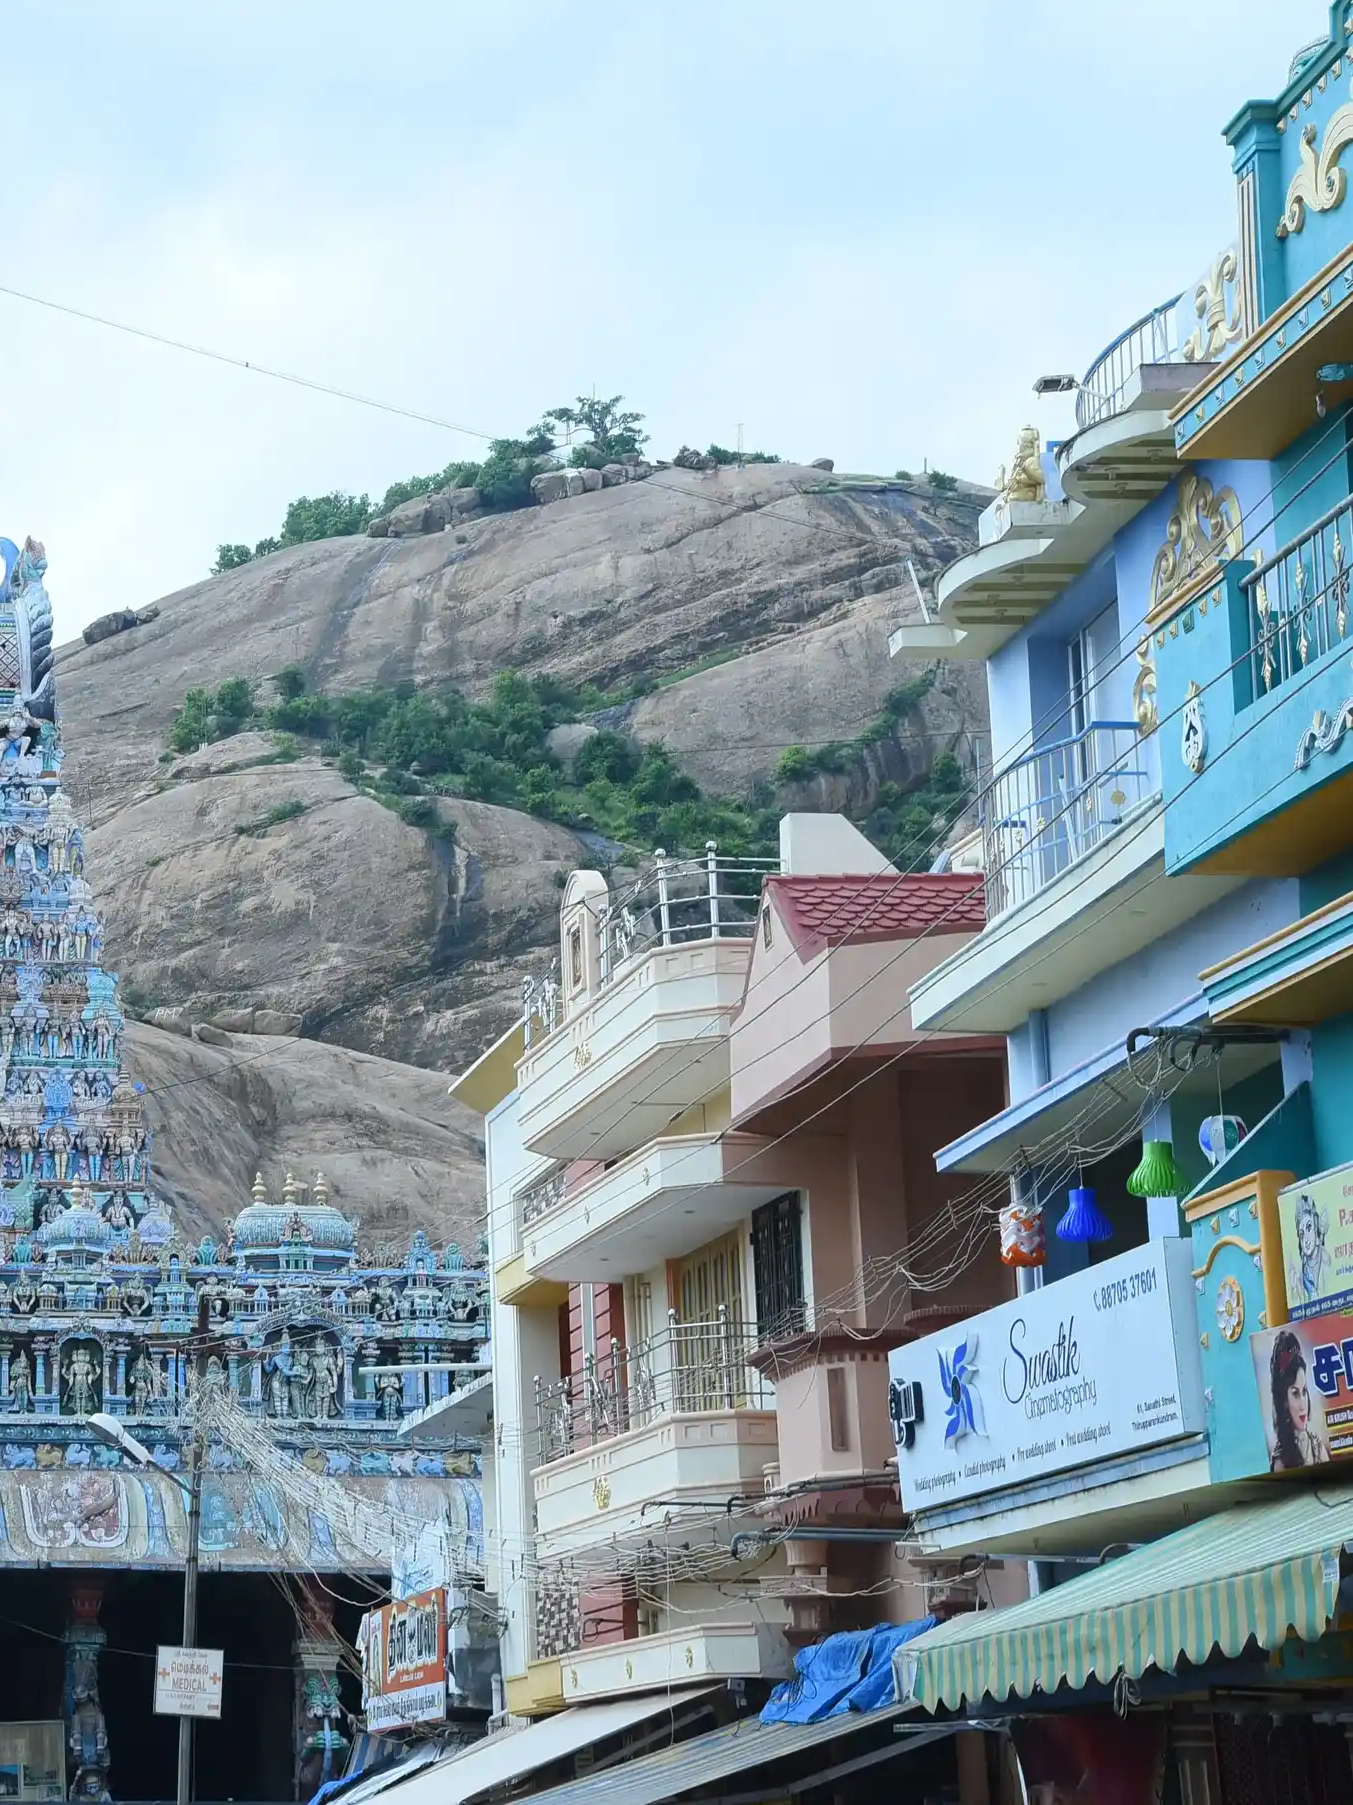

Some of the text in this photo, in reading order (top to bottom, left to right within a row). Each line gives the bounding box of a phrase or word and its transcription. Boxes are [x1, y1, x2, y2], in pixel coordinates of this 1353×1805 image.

[1100, 1266, 1158, 1310] 88705 37601
[1002, 1315, 1081, 1404] Swastik
[1024, 1376, 1097, 1420] Cinematography
[171, 1678, 207, 1692] MEDICAL
